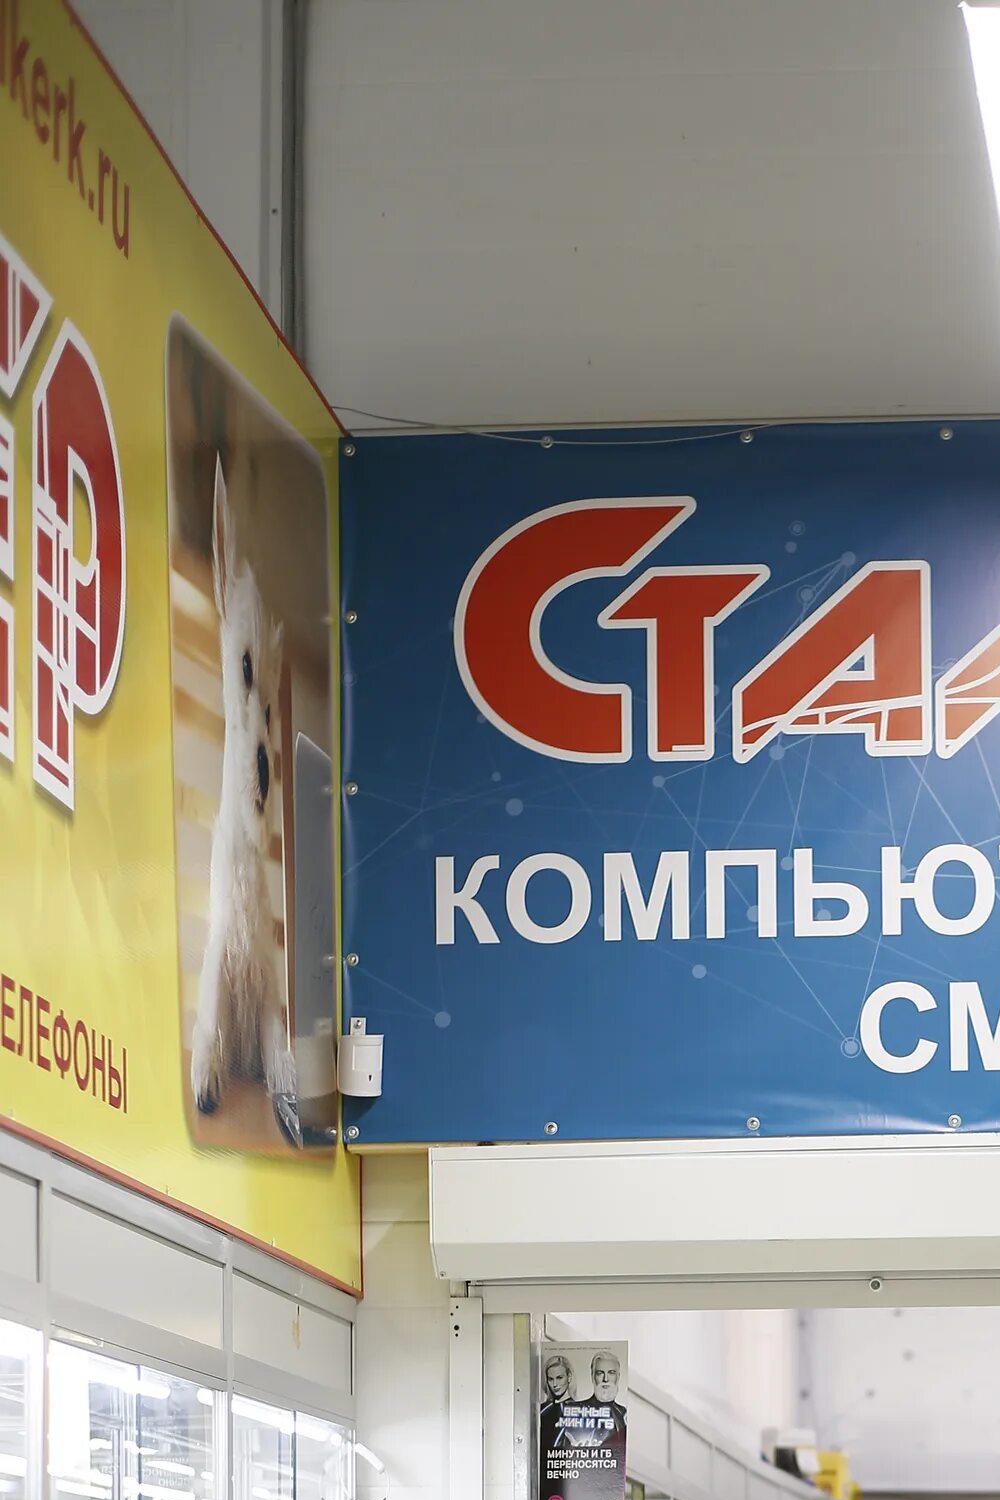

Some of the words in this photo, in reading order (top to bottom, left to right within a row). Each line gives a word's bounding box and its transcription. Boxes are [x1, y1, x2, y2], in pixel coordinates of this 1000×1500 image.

[563, 1406, 611, 1418] ВЕЧНЫЕ
[556, 1417, 583, 1428] МИН
[586, 1418, 595, 1428] И
[598, 1418, 615, 1430] ГБ
[547, 1449, 590, 1459] МИНУТЫ
[591, 1449, 598, 1458] И
[600, 1449, 612, 1458] ГБ
[547, 1459, 617, 1469] ПЕРЕНОСЯТСЯ
[546, 1470, 580, 1479] ВЕЧНО
